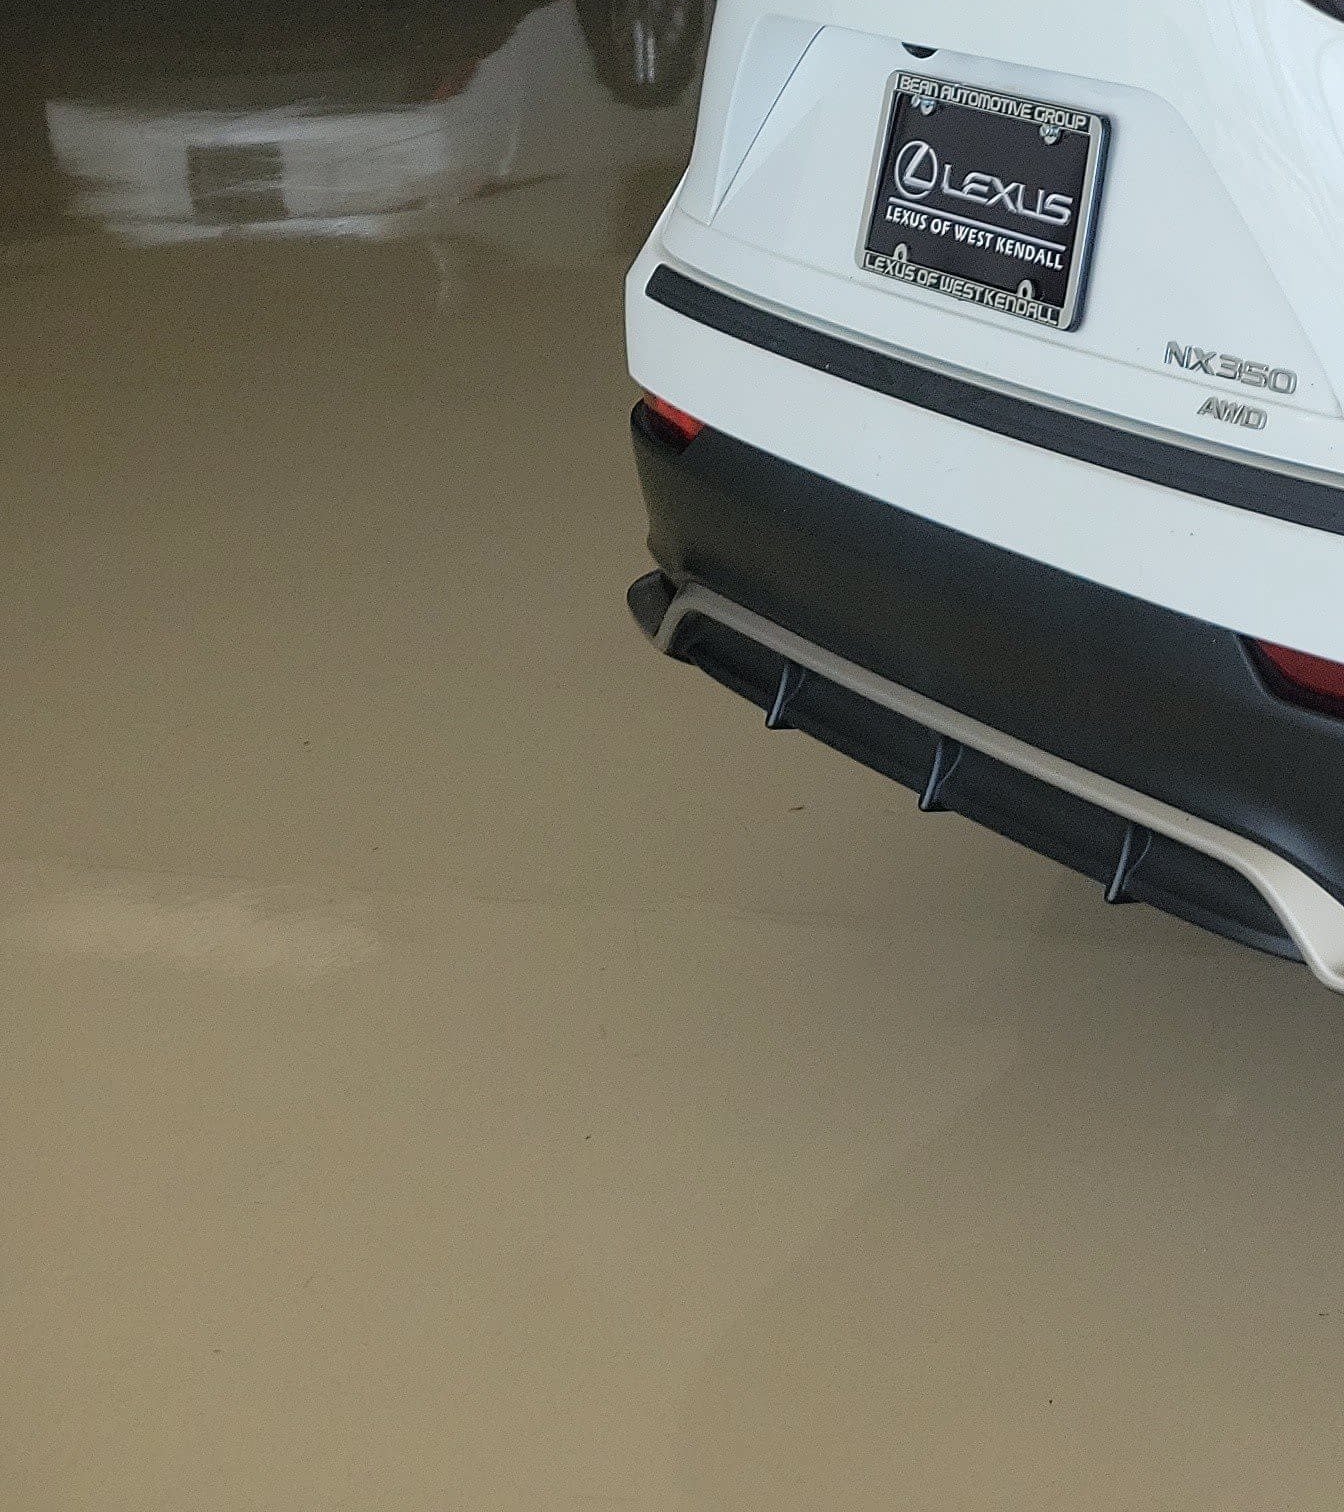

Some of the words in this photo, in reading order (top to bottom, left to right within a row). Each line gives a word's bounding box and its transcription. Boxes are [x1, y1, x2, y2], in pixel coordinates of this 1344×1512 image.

[900, 76, 940, 99] BEAN
[940, 84, 1033, 119] AUTOMOTIVE
[1034, 106, 1088, 130] GROUP
[942, 164, 1074, 226] LEXUS
[885, 205, 928, 231] LEXUS
[930, 218, 951, 235] OF
[953, 223, 993, 248] WEST
[996, 237, 1064, 271] KENDALL
[865, 254, 917, 282] LEXUS
[917, 268, 939, 287] OF
[939, 273, 986, 303] WEST
[984, 289, 1060, 325] KENDALL
[1196, 396, 1269, 430] AWD
